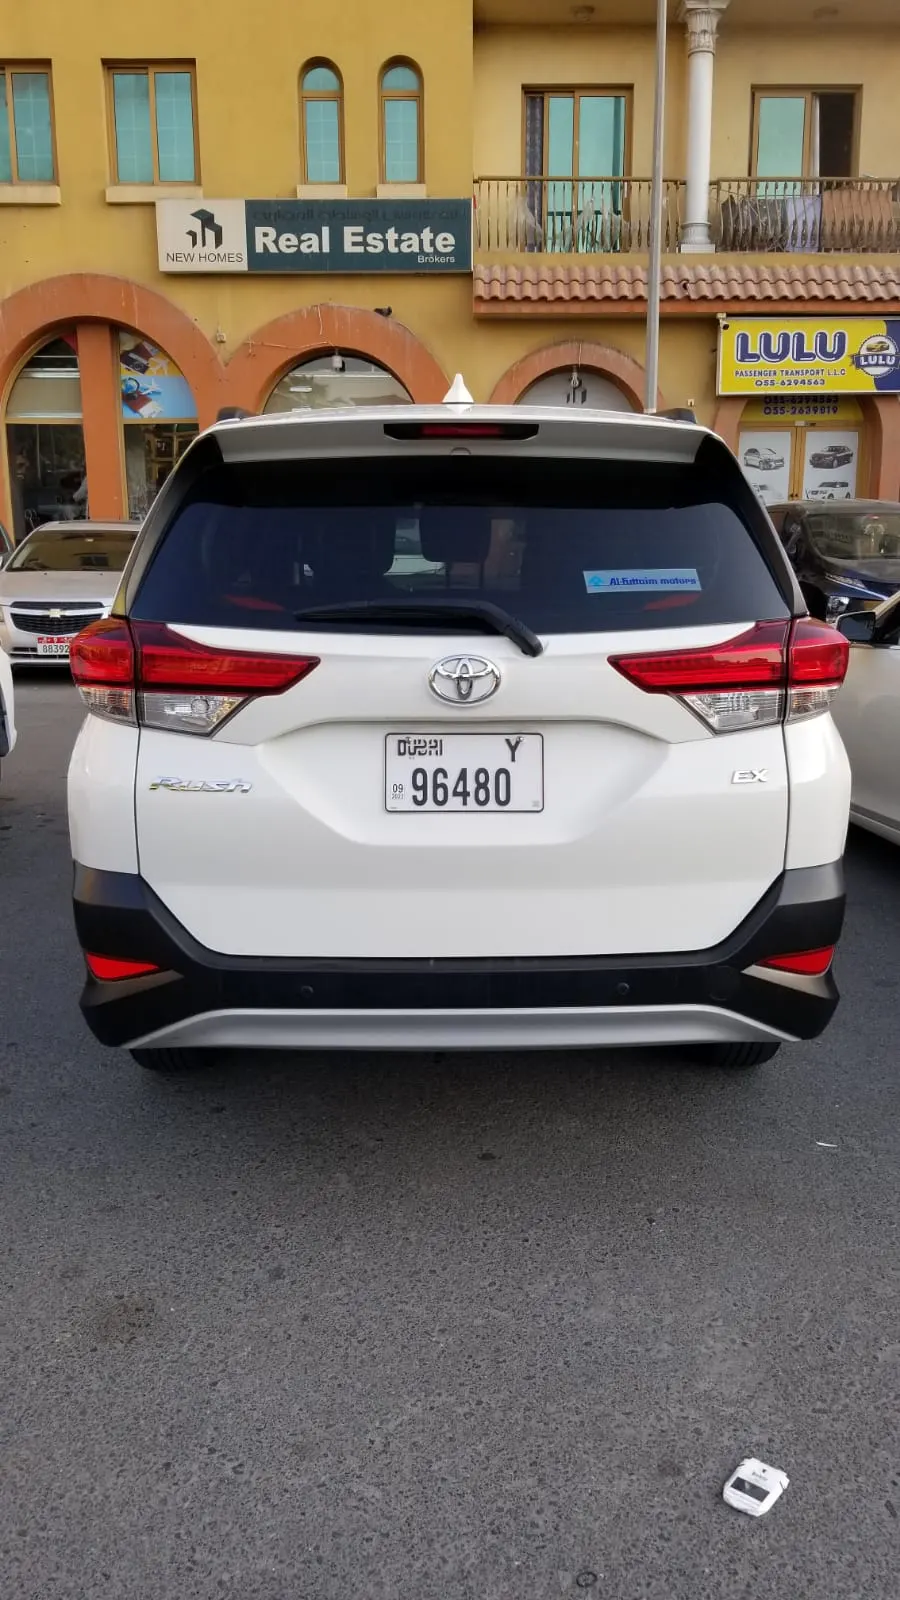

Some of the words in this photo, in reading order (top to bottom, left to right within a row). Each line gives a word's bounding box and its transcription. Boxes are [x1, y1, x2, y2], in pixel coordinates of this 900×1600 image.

[254, 226, 330, 253] Real
[343, 225, 456, 253] Estate
[166, 252, 194, 263] NEW
[198, 252, 244, 263] HOMES
[417, 254, 456, 264] Brokers
[735, 331, 847, 364] LULU
[859, 355, 896, 366] LULU
[781, 369, 824, 377] TRANSPORT
[755, 379, 825, 387] 055-6294563
[505, 738, 523, 763] Y
[731, 769, 768, 784] EX
[149, 776, 252, 793] Rush
[392, 783, 404, 793] 09
[411, 767, 512, 807] 96480
